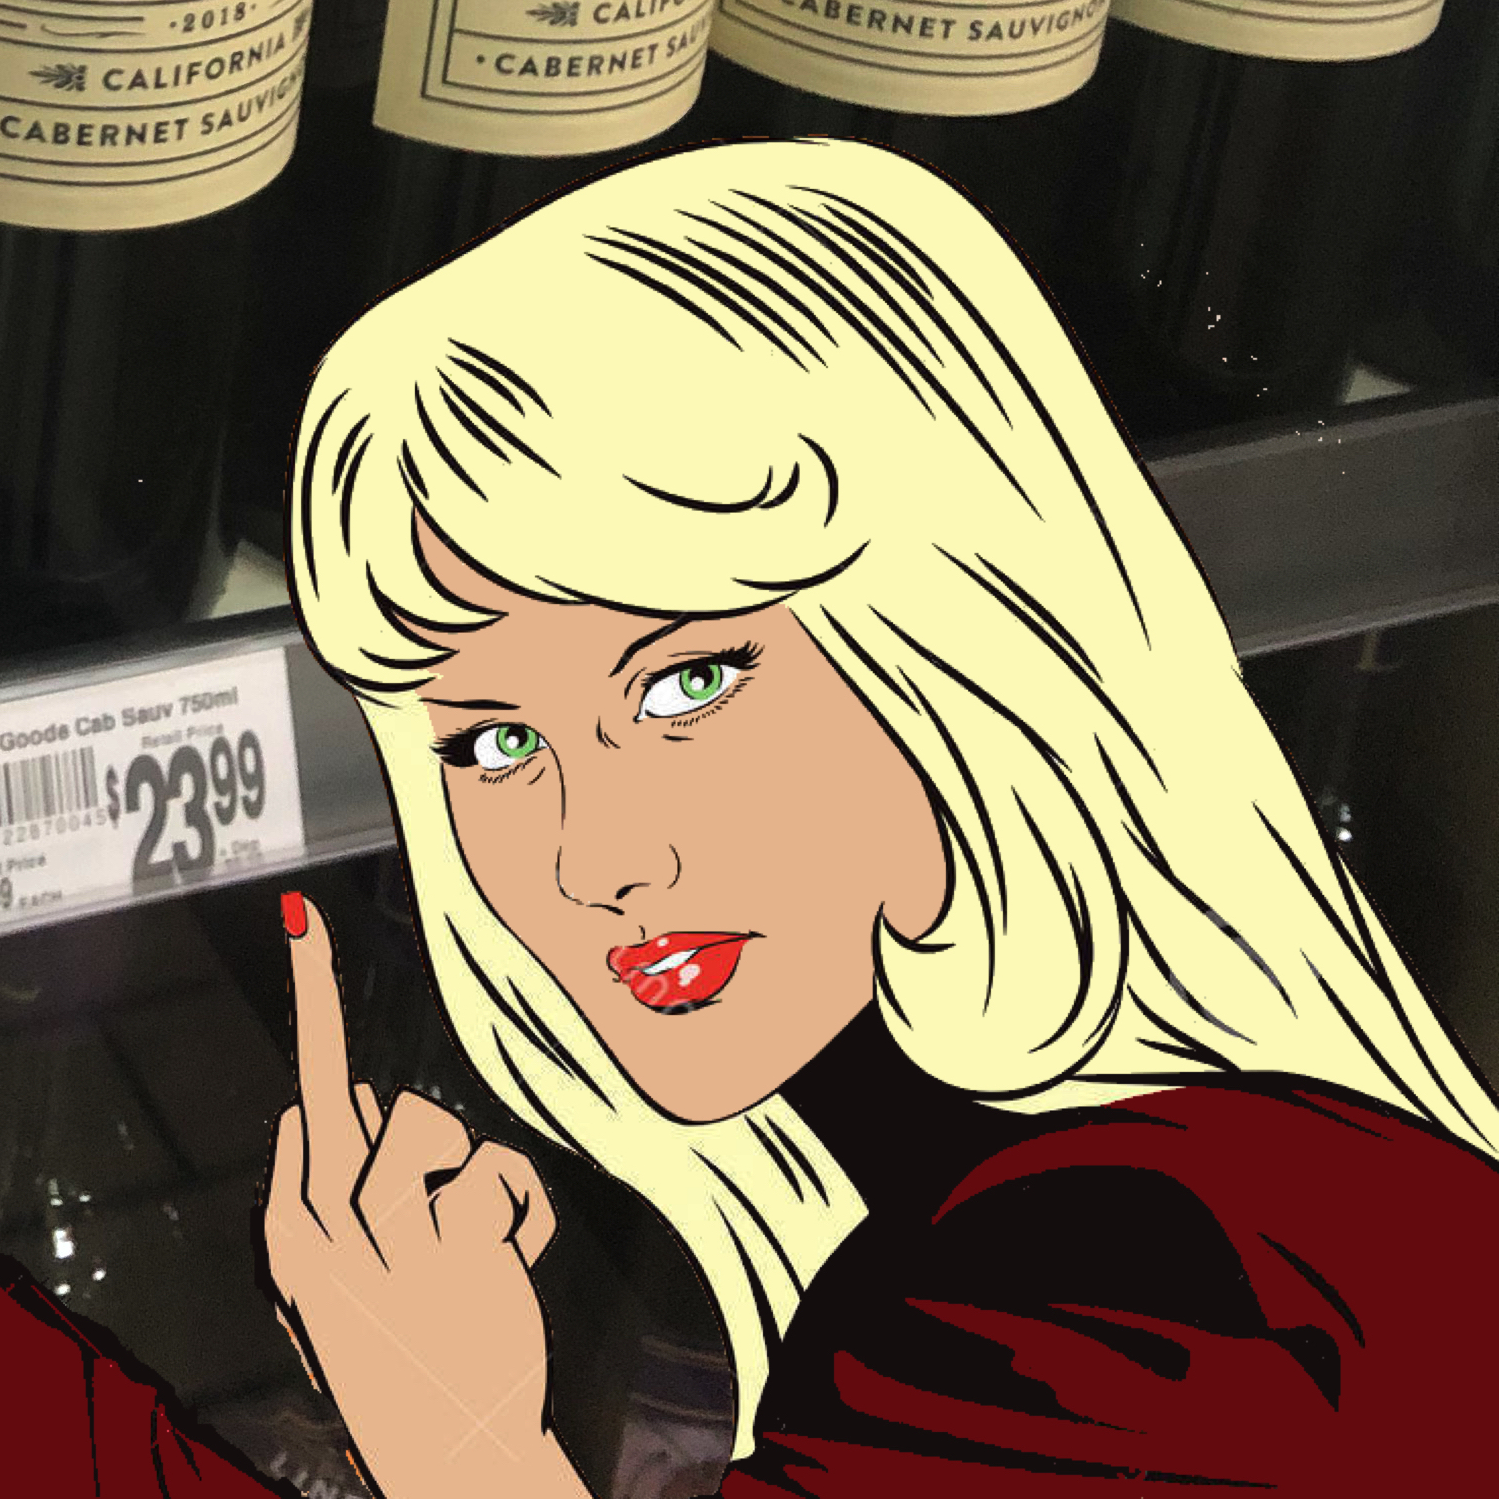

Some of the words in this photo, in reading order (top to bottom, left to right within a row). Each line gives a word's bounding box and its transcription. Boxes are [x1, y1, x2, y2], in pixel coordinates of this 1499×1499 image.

[101, 32, 286, 90] CALIFORNIA
[494, 43, 659, 78] CABERNET
[0, 115, 189, 146] CABERNET
[75, 712, 116, 737] Cab
[121, 703, 174, 727] Sauv
[178, 686, 238, 716] 750ml
